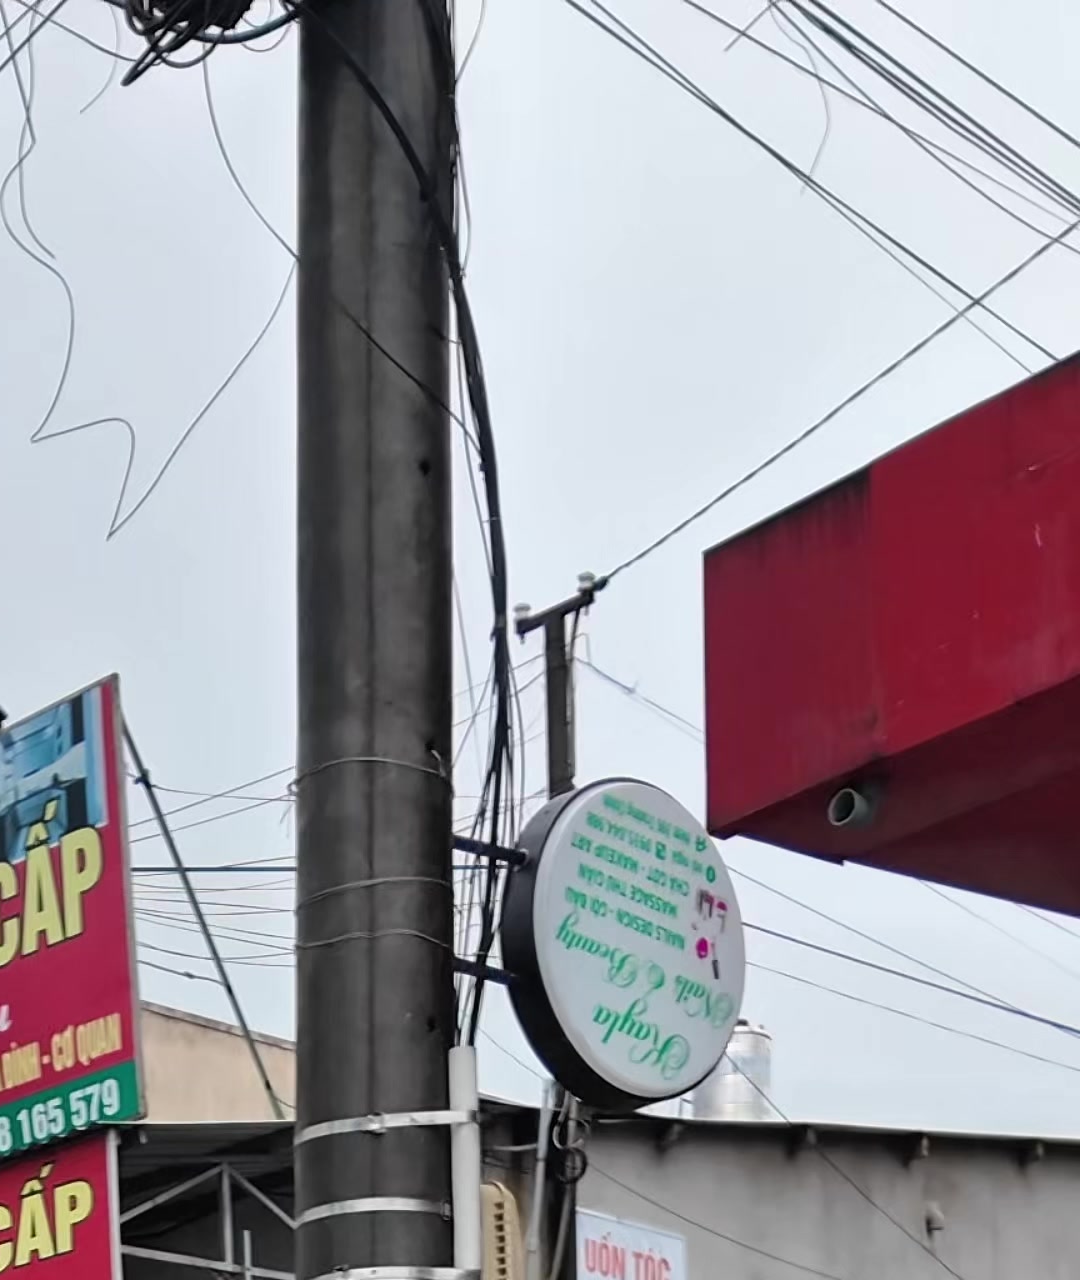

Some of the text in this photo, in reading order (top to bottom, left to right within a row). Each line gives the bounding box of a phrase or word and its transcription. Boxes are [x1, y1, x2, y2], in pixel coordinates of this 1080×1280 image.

[630, 885, 678, 918] MASSAGE
[555, 911, 637, 988] Beauty
[675, 974, 733, 1029] Nails
[76, 1012, 122, 1066] QUAN
[592, 998, 690, 1080] Kayla
[16, 1097, 66, 1145] 165
[70, 1078, 121, 1122] 579
[584, 1232, 625, 1280] UỐN
